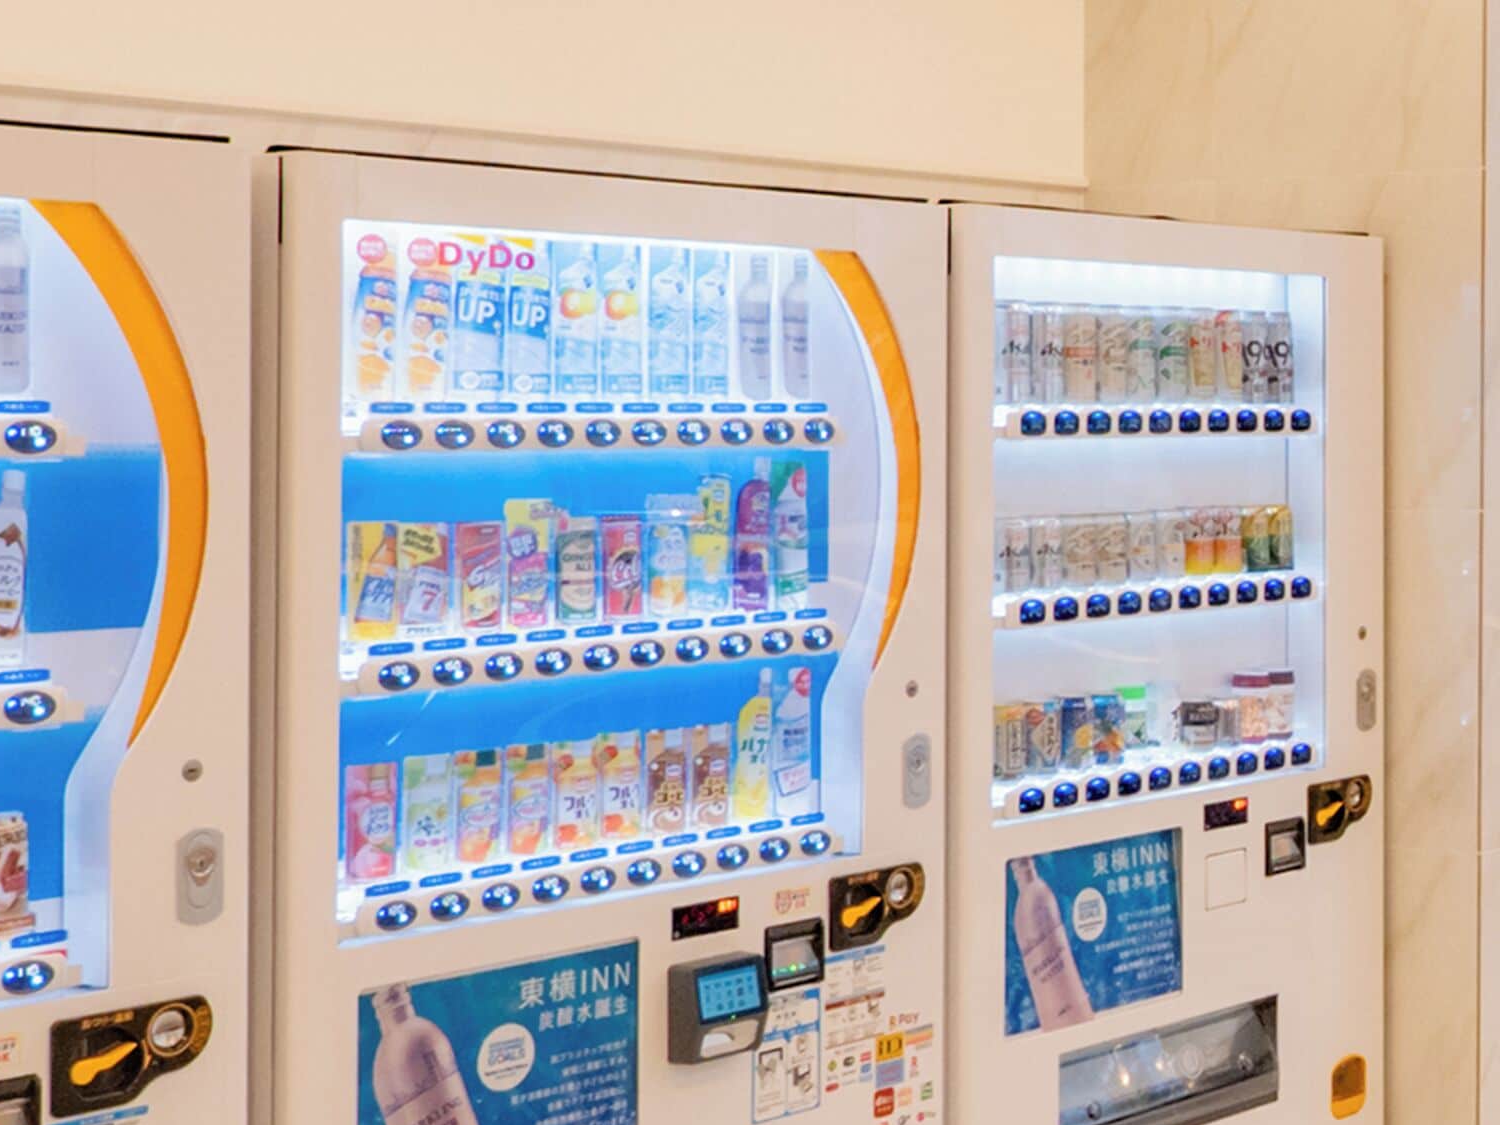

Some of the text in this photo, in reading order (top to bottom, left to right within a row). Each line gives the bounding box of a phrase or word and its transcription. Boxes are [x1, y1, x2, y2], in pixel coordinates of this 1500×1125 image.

[437, 241, 536, 276] DyDo
[458, 298, 497, 325] UP
[511, 302, 547, 328] UP
[517, 961, 632, 1010] 東横INN
[538, 995, 628, 1032] 炭酸水誕生
